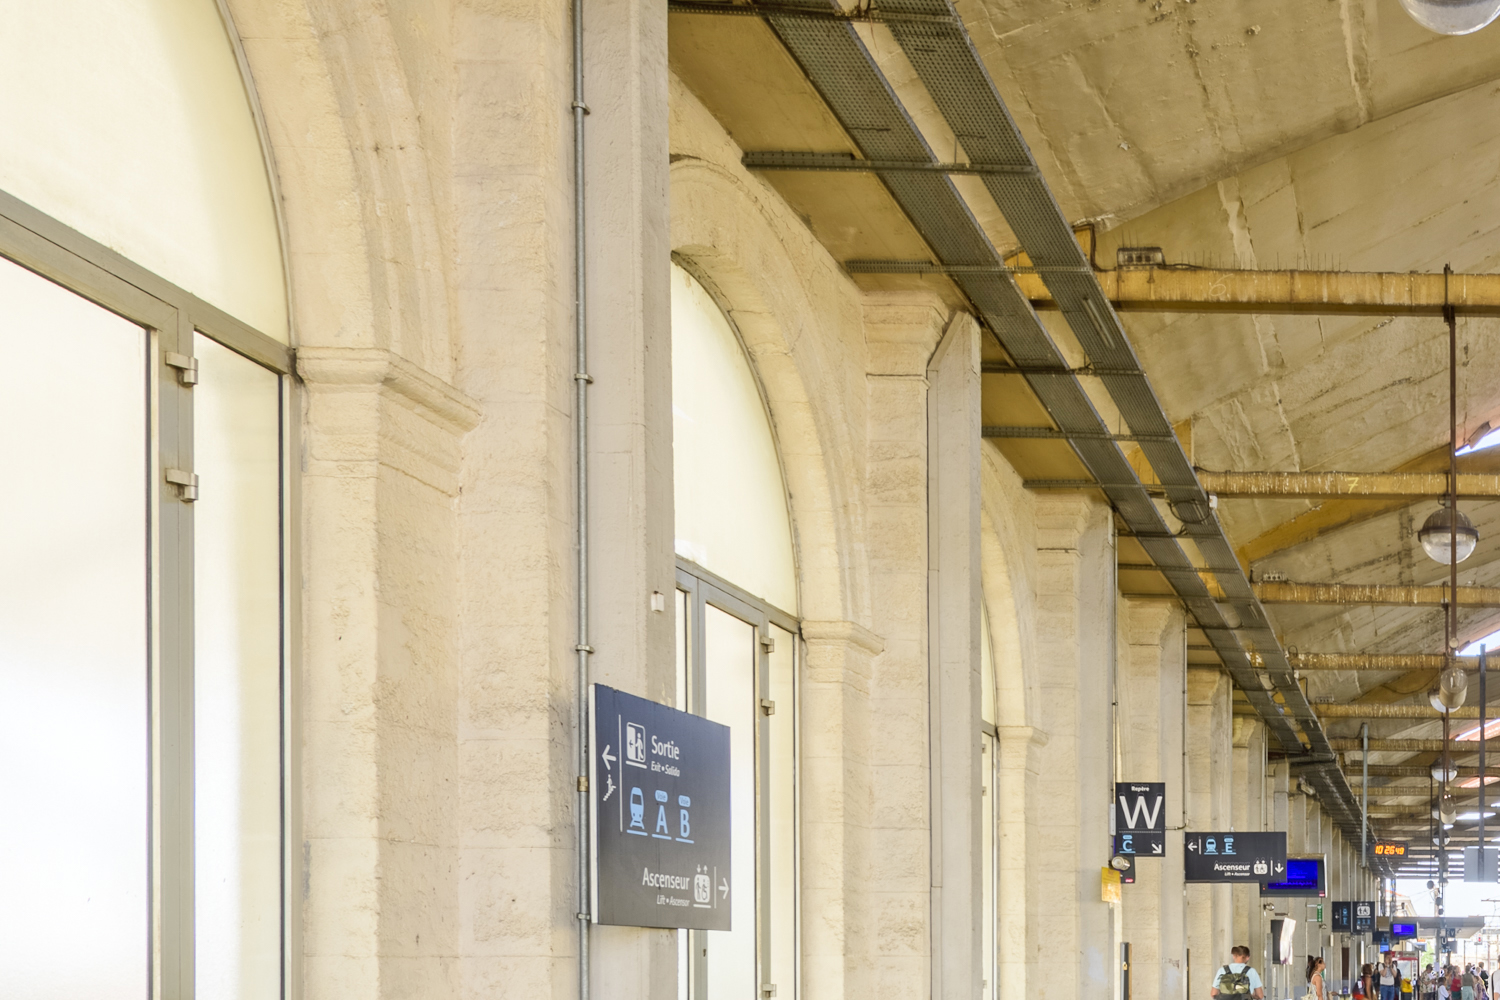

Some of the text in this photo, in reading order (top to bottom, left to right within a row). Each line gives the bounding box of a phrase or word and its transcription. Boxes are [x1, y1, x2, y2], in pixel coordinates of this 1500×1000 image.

[1347, 476, 1359, 494] 7
[651, 735, 680, 760] Sortie
[651, 761, 661, 773] Exit
[655, 804, 669, 835] A
[1119, 795, 1163, 830] W
[679, 808, 691, 838] B
[1122, 840, 1133, 852] C
[1225, 842, 1233, 853] E
[1375, 845, 1384, 855] 10
[1384, 845, 1396, 855] 26
[1213, 863, 1251, 871] Ascenseur
[642, 866, 691, 891] Ascenseur
[656, 894, 666, 906] Lift
